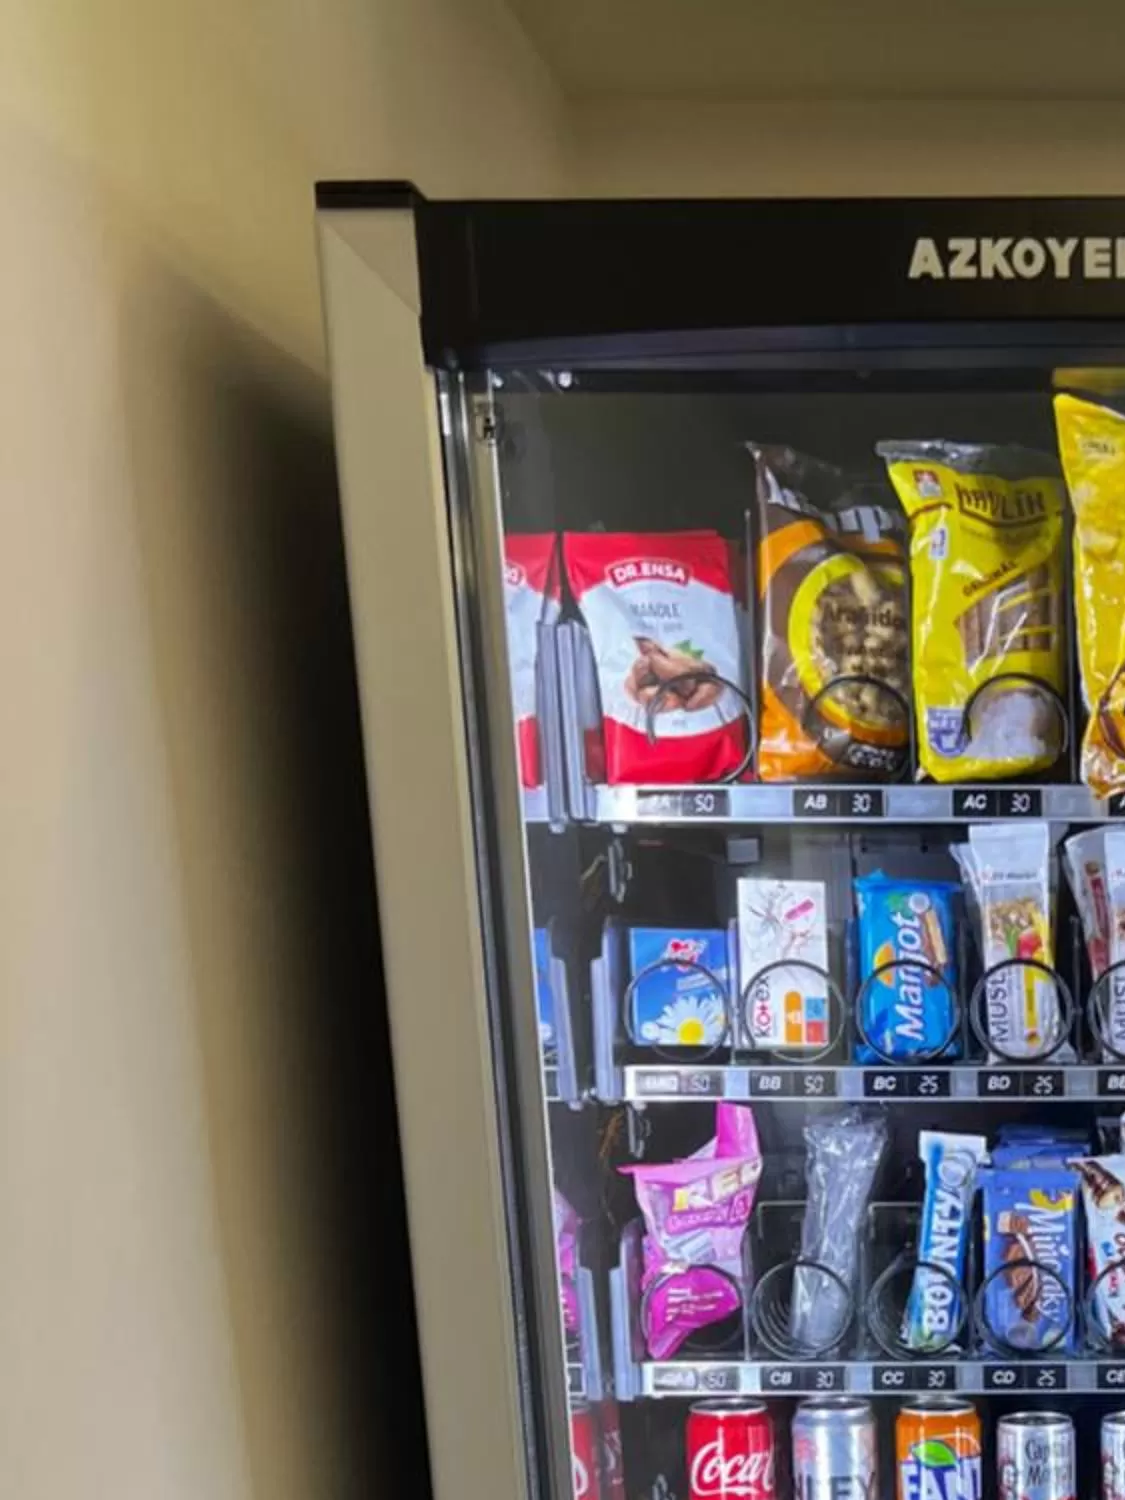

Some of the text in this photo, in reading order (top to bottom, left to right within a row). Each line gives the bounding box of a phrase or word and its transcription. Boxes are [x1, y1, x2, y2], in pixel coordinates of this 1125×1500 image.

[694, 794, 715, 813] 50
[804, 795, 872, 813] AB 30
[963, 794, 1031, 813] AC 30
[988, 970, 1009, 1044] MUSL
[759, 1075, 824, 1094] BB 50
[873, 1075, 939, 1094] BC 25
[987, 1075, 1054, 1094] BD 25
[706, 1372, 726, 1388] 50
[769, 1370, 835, 1388] CB 30
[881, 1369, 947, 1388] CC 30
[992, 1369, 1056, 1388] CD 25
[690, 1440, 774, 1497] Coca
